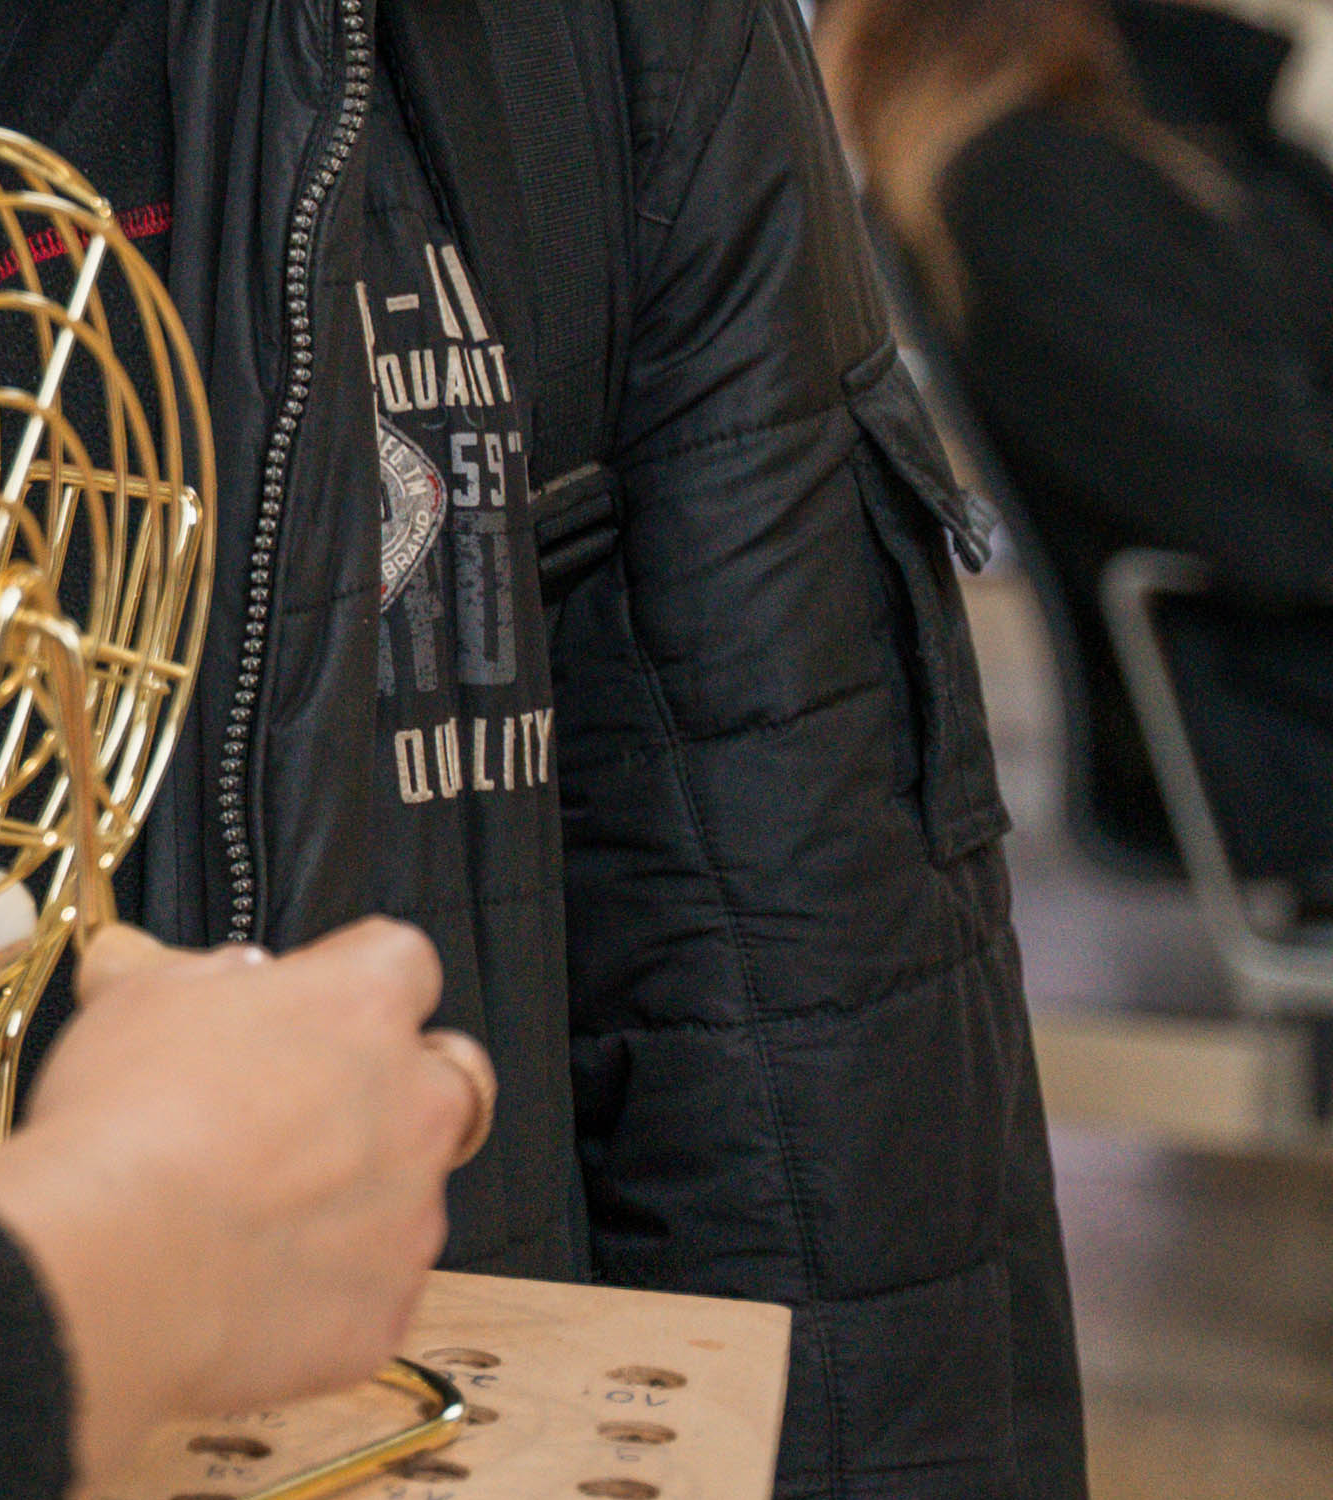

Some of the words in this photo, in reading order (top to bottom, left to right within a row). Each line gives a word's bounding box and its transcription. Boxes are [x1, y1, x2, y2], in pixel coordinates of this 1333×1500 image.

[381, 510, 431, 580] BRAND
[394, 707, 555, 805] QULITY
[604, 1390, 669, 1408] 10
